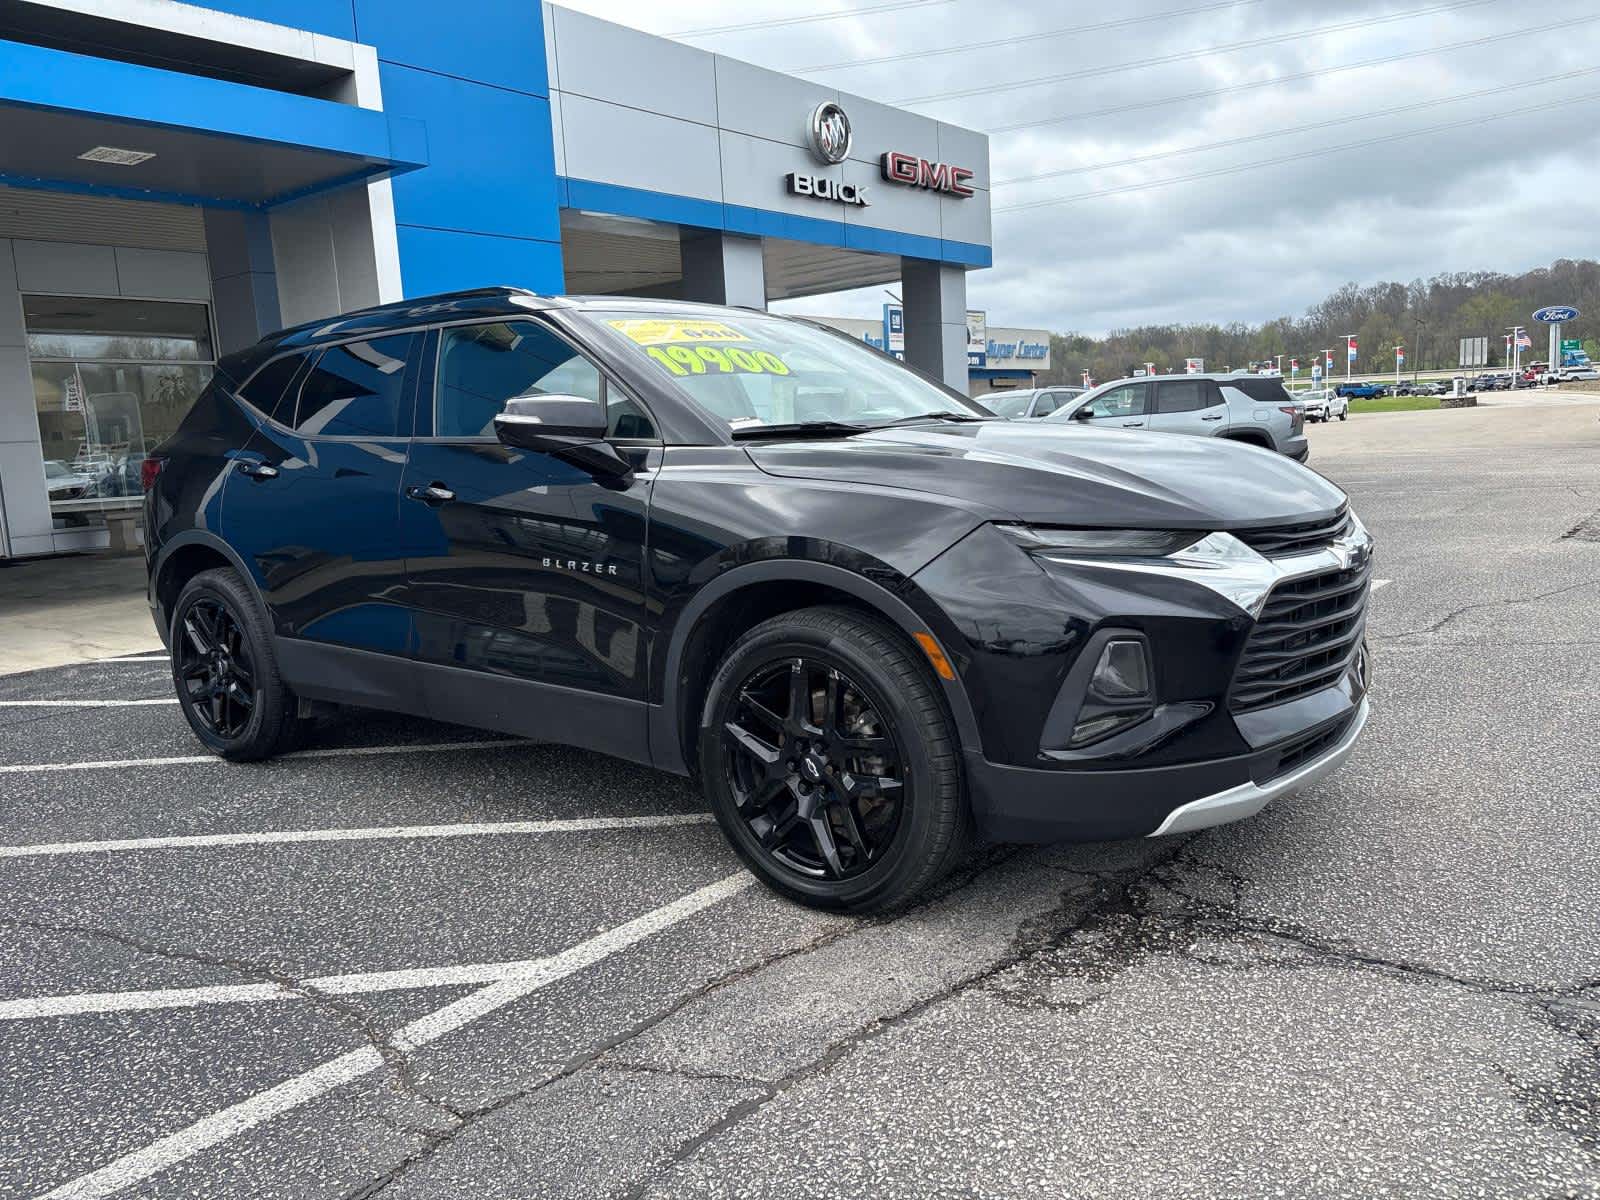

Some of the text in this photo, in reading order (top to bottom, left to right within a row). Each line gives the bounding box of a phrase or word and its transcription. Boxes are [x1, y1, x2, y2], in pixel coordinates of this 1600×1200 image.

[786, 172, 870, 206] BUICK
[881, 151, 974, 197] GMC
[1542, 310, 1570, 321] Ford
[646, 346, 789, 377] 19900
[542, 558, 617, 575] BLAZER
